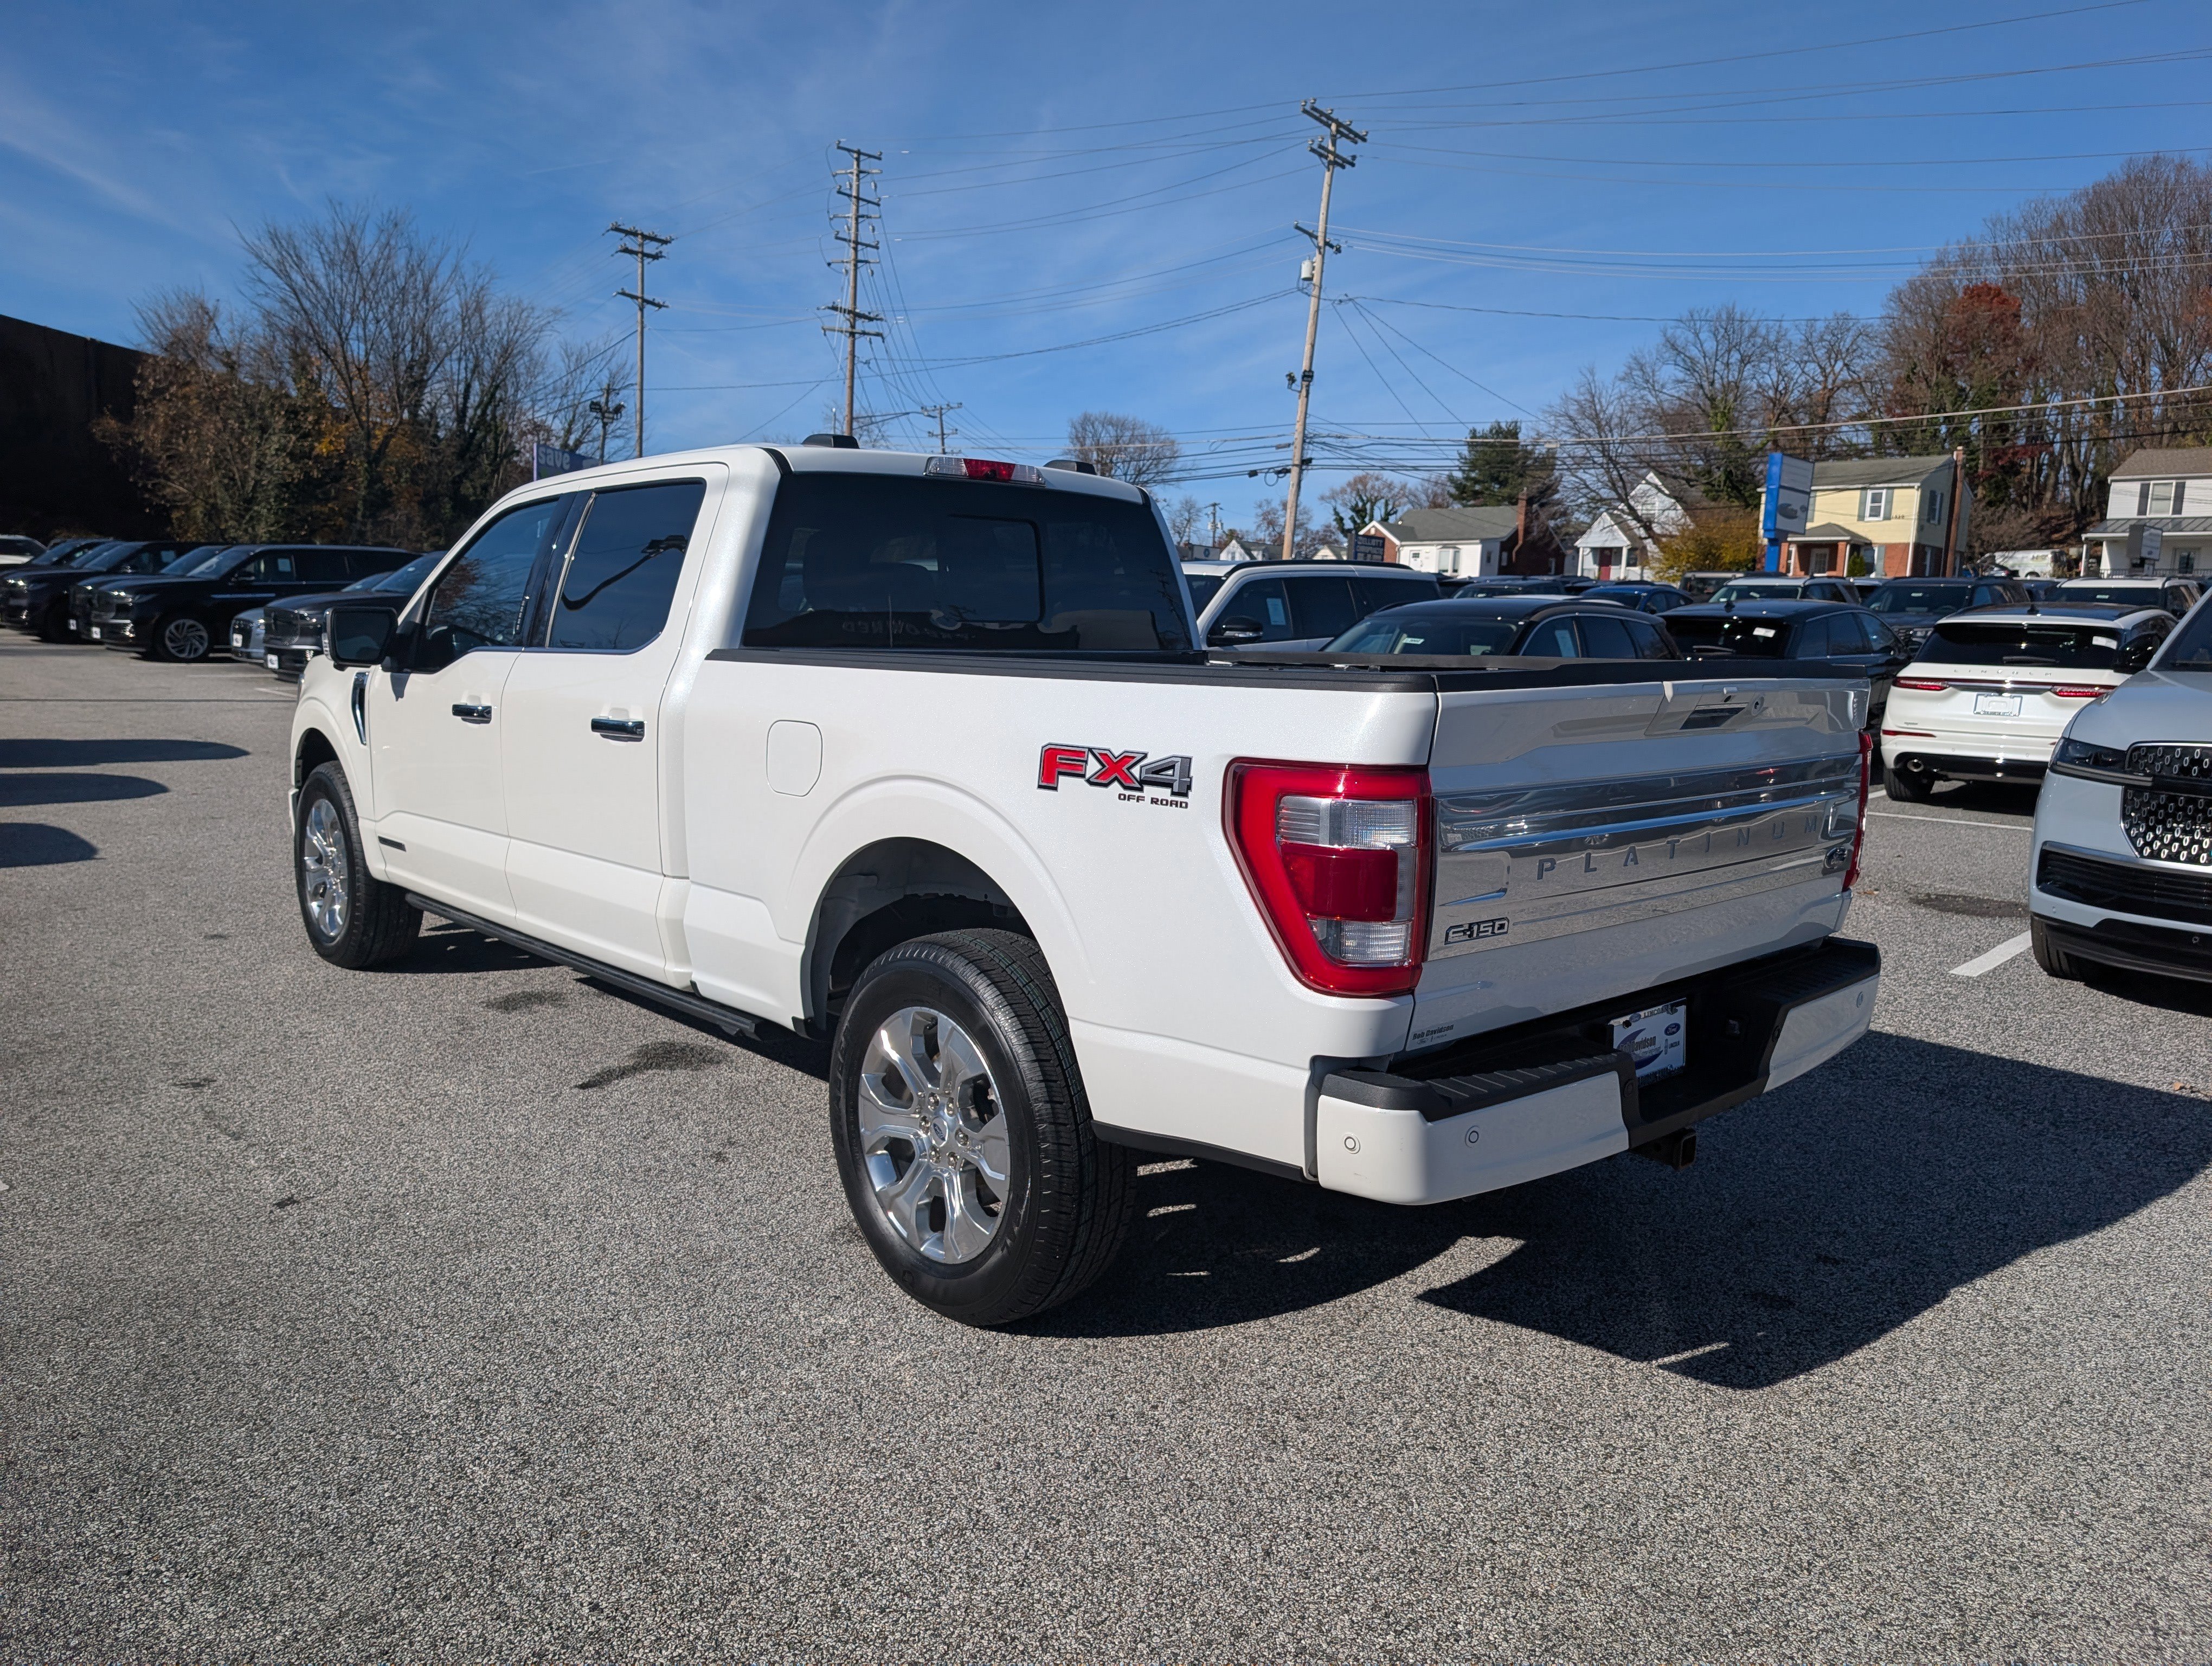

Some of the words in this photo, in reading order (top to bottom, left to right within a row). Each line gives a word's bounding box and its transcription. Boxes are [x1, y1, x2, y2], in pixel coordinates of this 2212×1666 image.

[538, 446, 570, 470] save
[1954, 669, 2052, 677] LINCOLN
[1037, 742, 1193, 798] FX4
[1118, 793, 1145, 803] OFF
[1150, 797, 1189, 809] ROAD
[1537, 815, 1817, 880] PLATINUM
[1445, 918, 1509, 944] F-150
[1412, 1031, 1425, 1040] Bob
[1426, 1024, 1454, 1037] Davidson
[1666, 1024, 1680, 1035] Ford
[1630, 1036, 1656, 1053] Davidson
